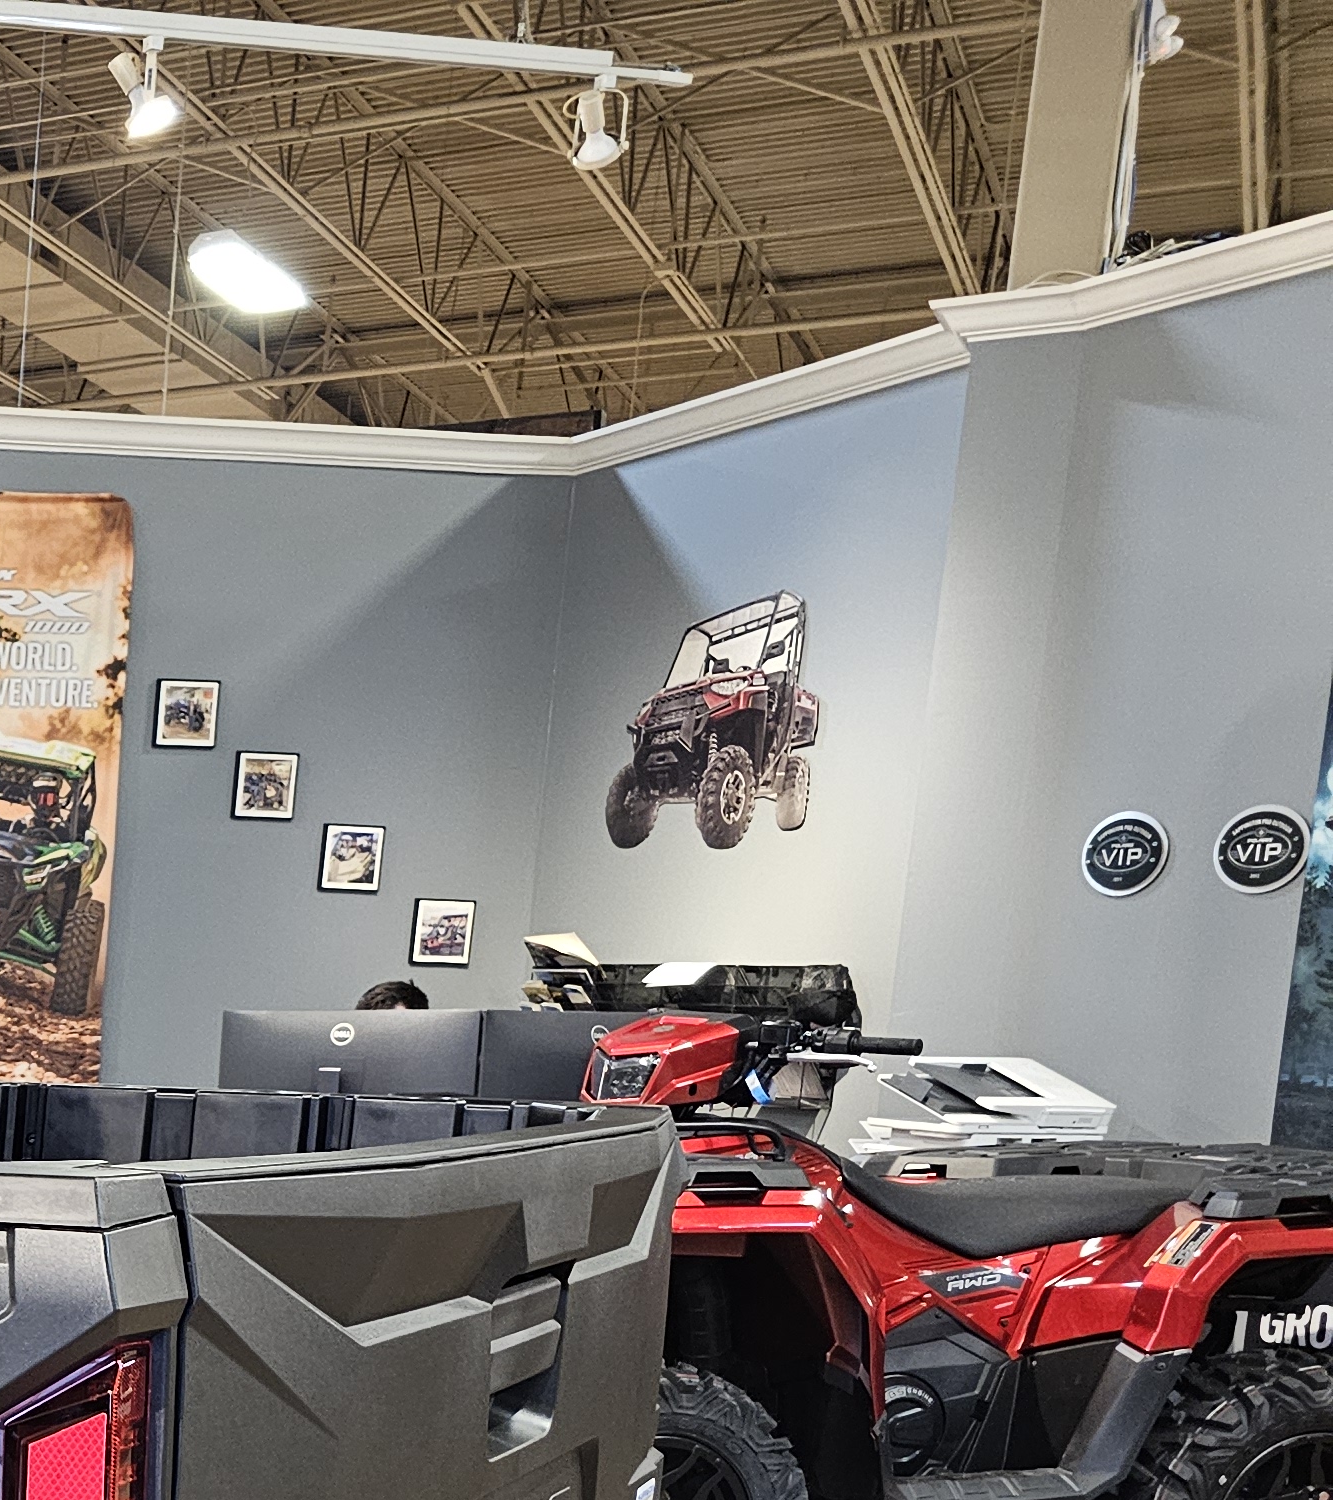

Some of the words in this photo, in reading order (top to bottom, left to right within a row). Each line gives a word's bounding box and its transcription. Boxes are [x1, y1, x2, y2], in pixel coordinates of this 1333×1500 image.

[23, 620, 91, 634] 1000
[1101, 847, 1143, 866] VIP
[1236, 843, 1282, 862] VIP
[947, 1274, 1001, 1291] AWD
